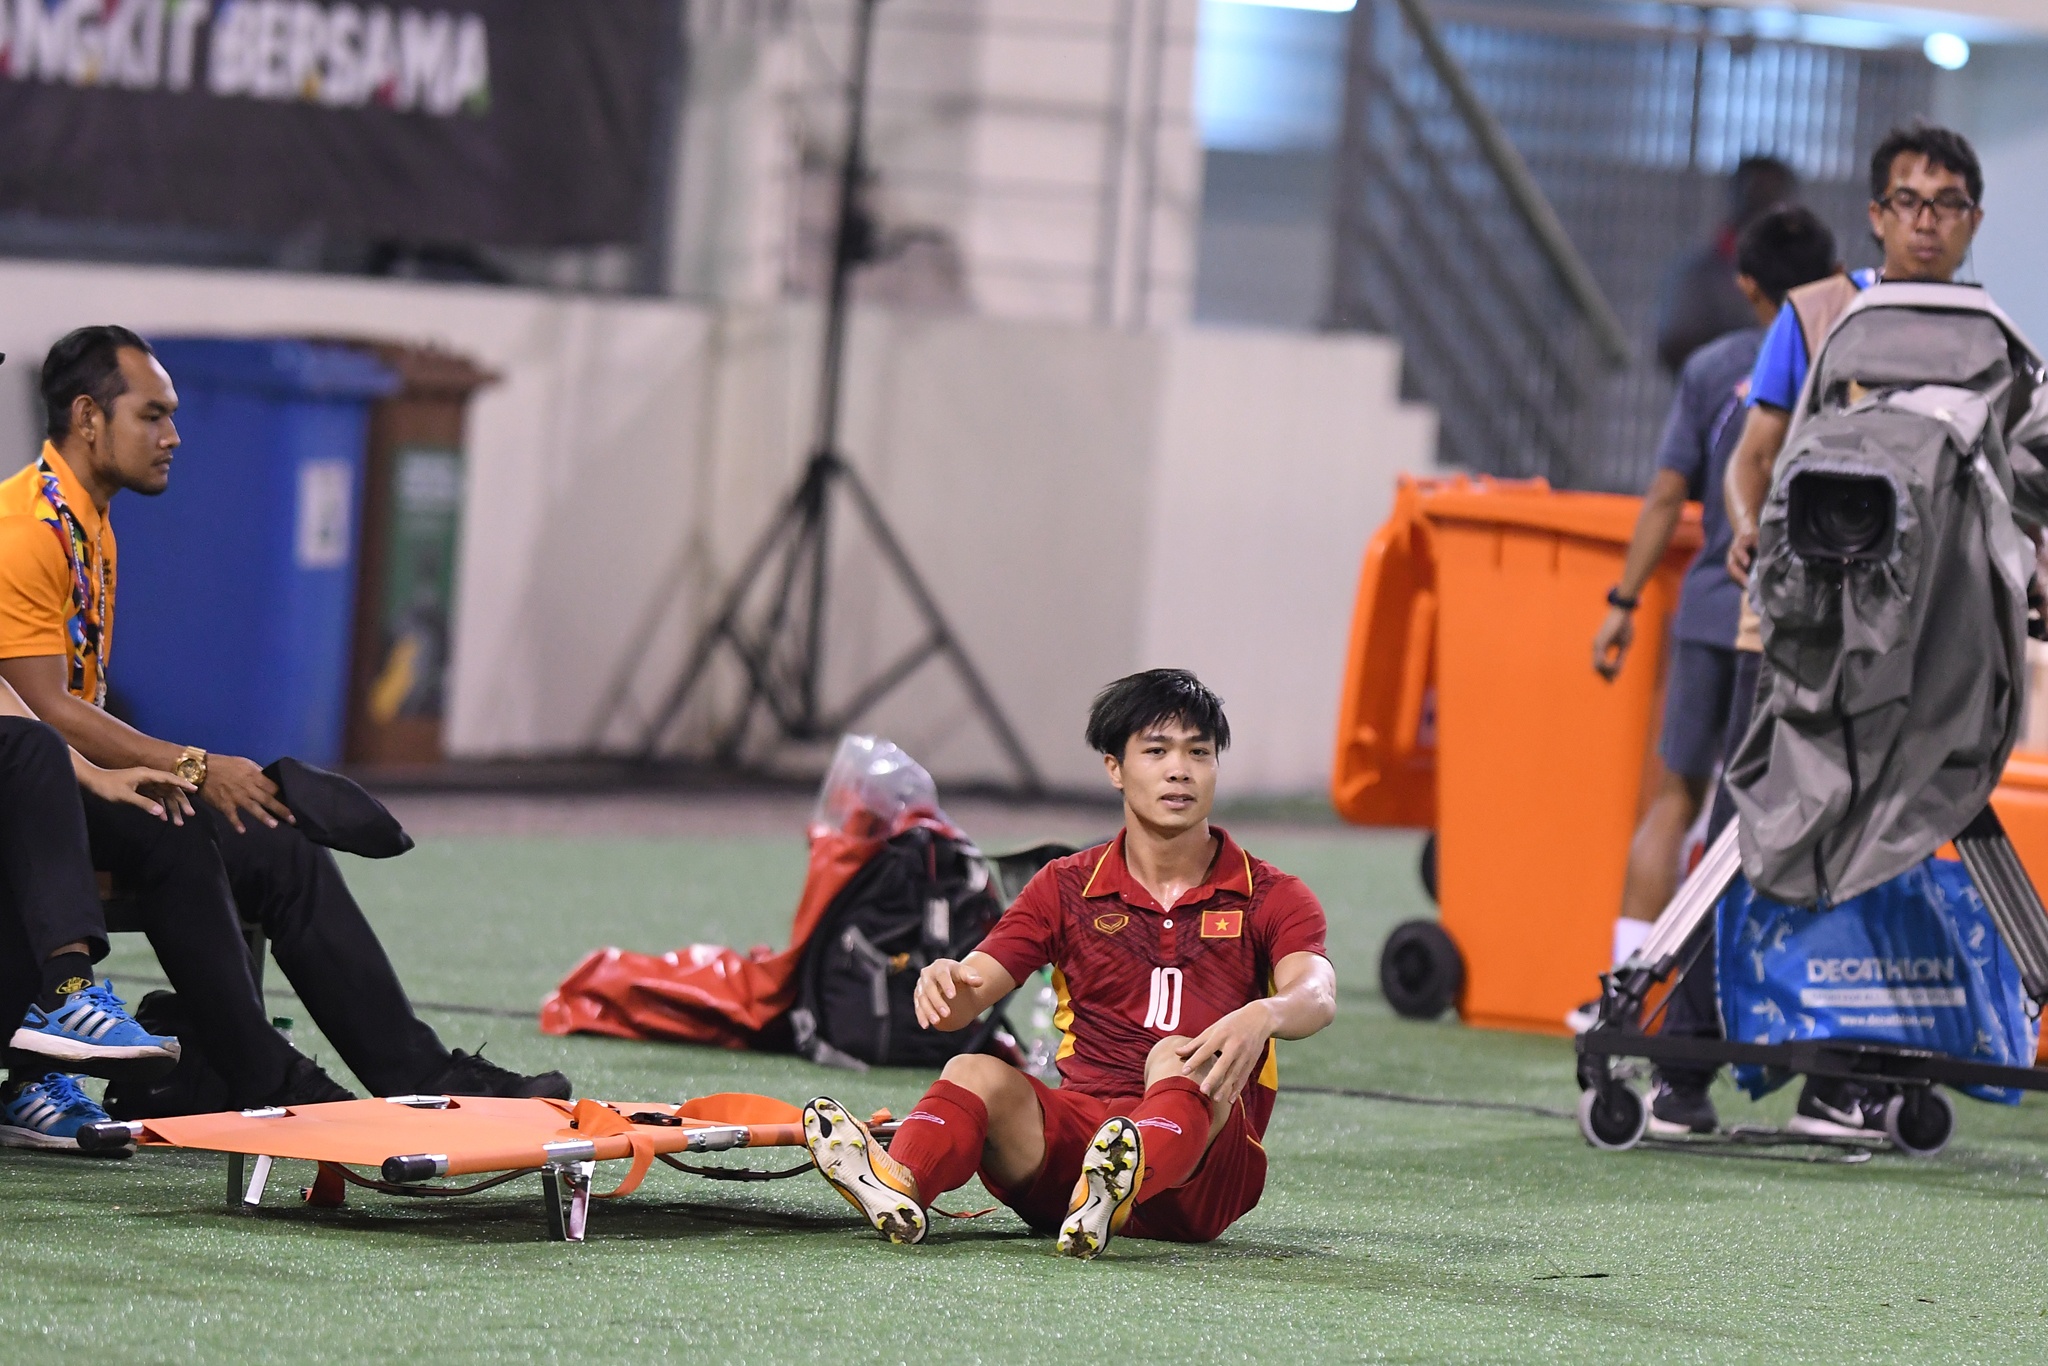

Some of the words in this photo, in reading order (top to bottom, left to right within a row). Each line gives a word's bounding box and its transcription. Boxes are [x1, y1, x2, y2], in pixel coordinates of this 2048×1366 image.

[208, 0, 490, 116] BERSAMA
[1144, 967, 1183, 1031] 10
[1807, 957, 1954, 983] DECATHLON
